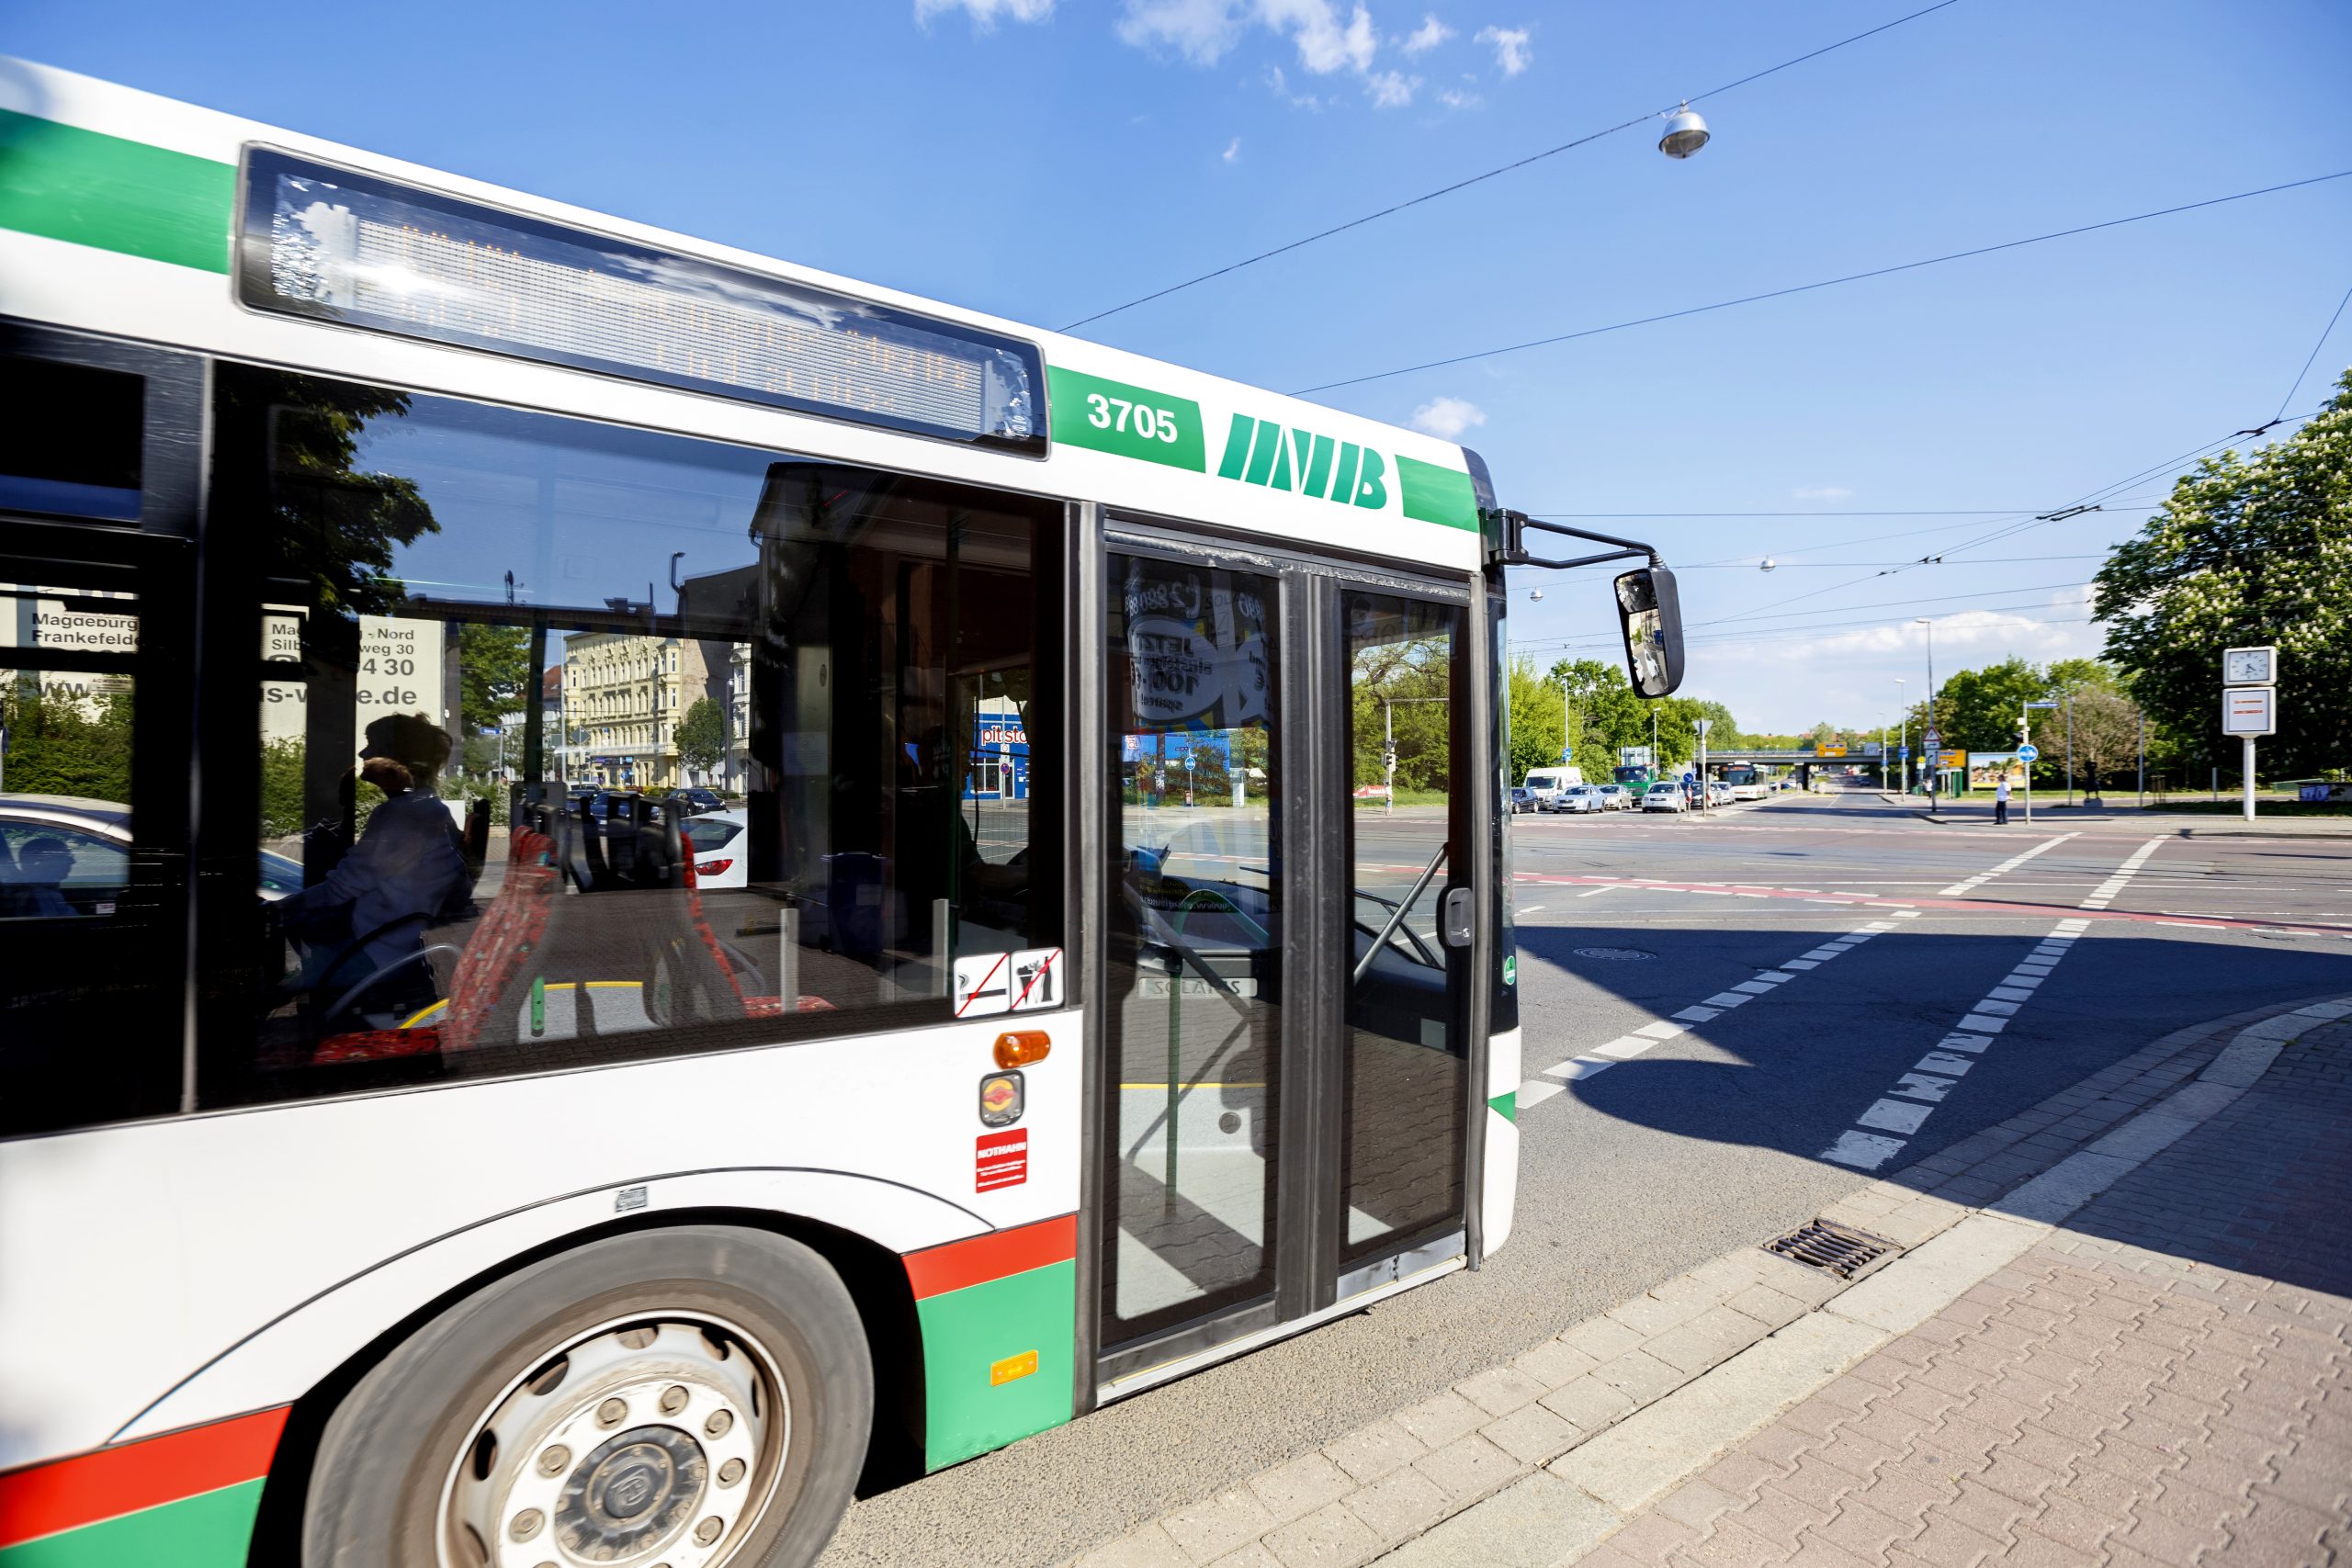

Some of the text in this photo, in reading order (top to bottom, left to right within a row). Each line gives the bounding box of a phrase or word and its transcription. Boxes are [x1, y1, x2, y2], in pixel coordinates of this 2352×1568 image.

[1087, 393, 1178, 443] 3705
[32, 613, 139, 632] Magdeburg
[378, 628, 414, 640] Nord
[396, 644, 414, 655] 30
[384, 659, 414, 675] 30
